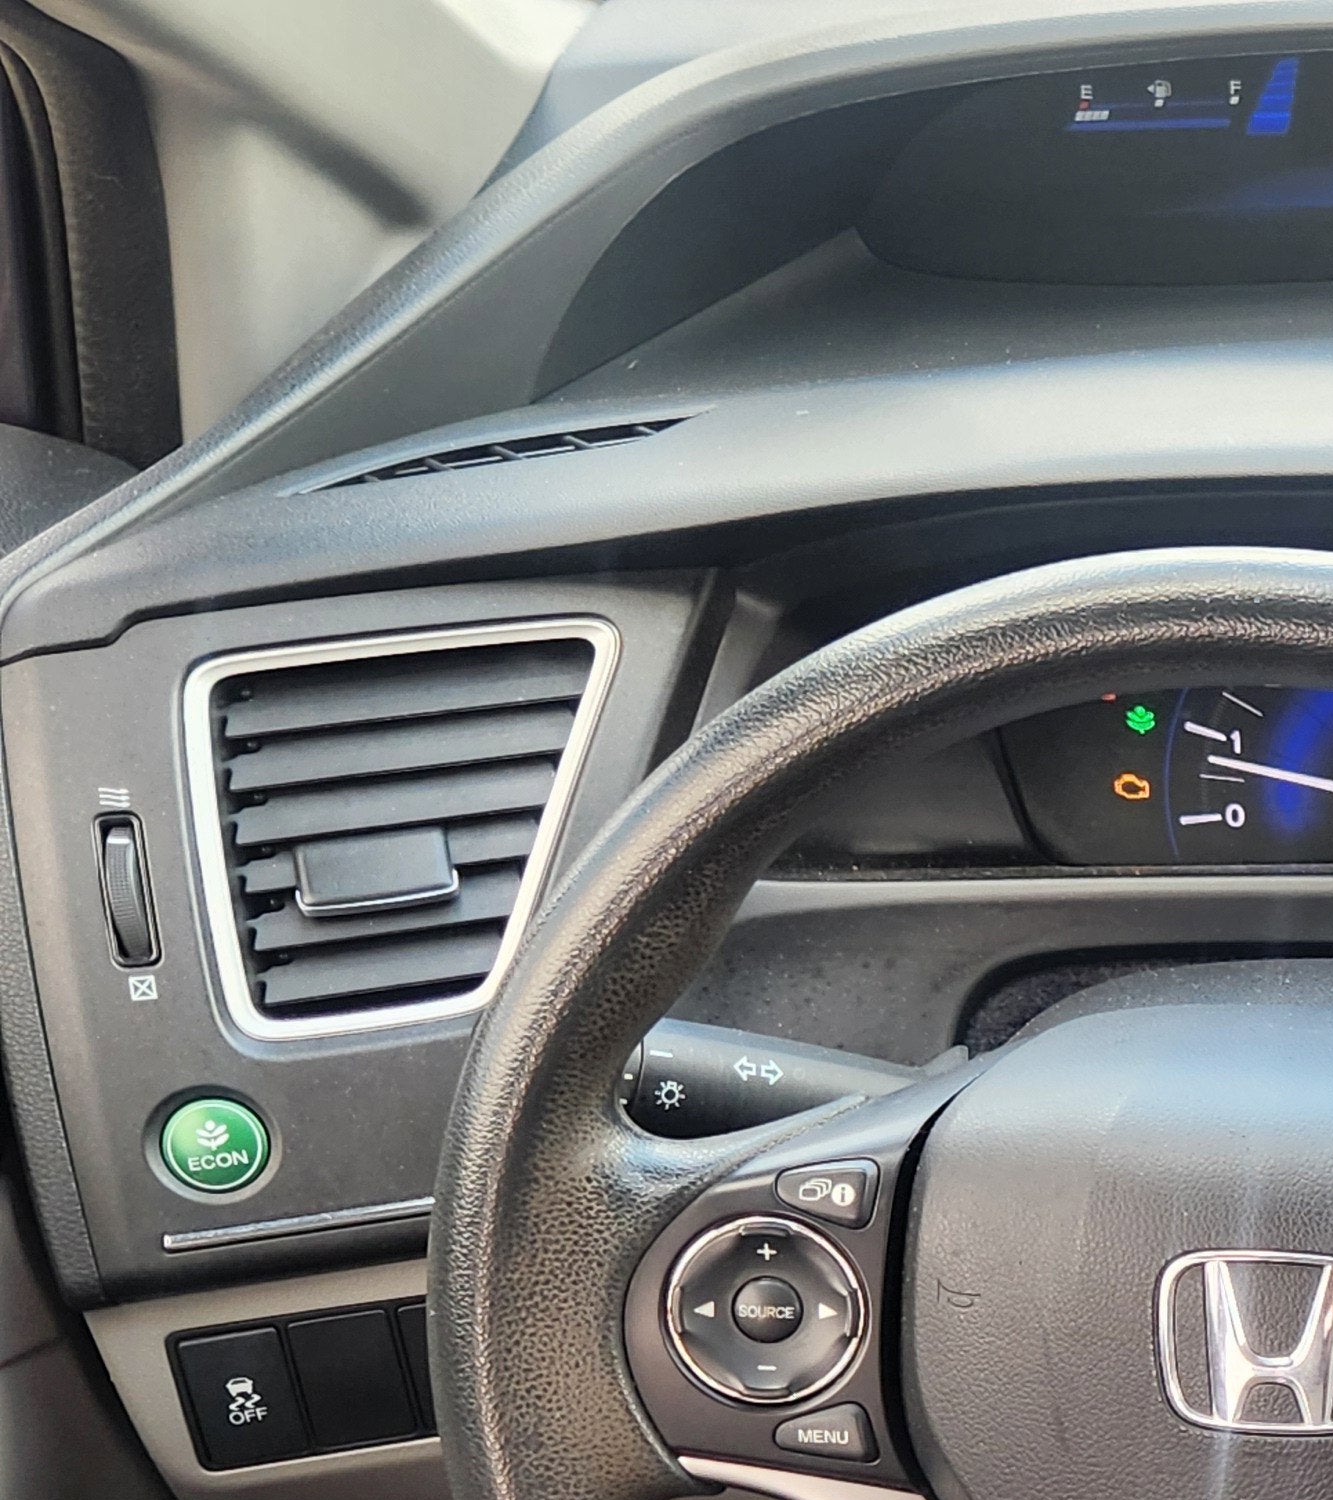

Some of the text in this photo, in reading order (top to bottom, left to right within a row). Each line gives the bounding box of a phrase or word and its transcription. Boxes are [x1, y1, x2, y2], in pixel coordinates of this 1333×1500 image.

[1080, 84, 1093, 100] E
[1229, 80, 1242, 95] F
[1229, 729, 1242, 755] 1
[1224, 803, 1246, 828] 0
[187, 1149, 250, 1172] ECON
[738, 1303, 796, 1320] SOURCE
[228, 1405, 268, 1426] OFF
[797, 1428, 849, 1446] MENU
